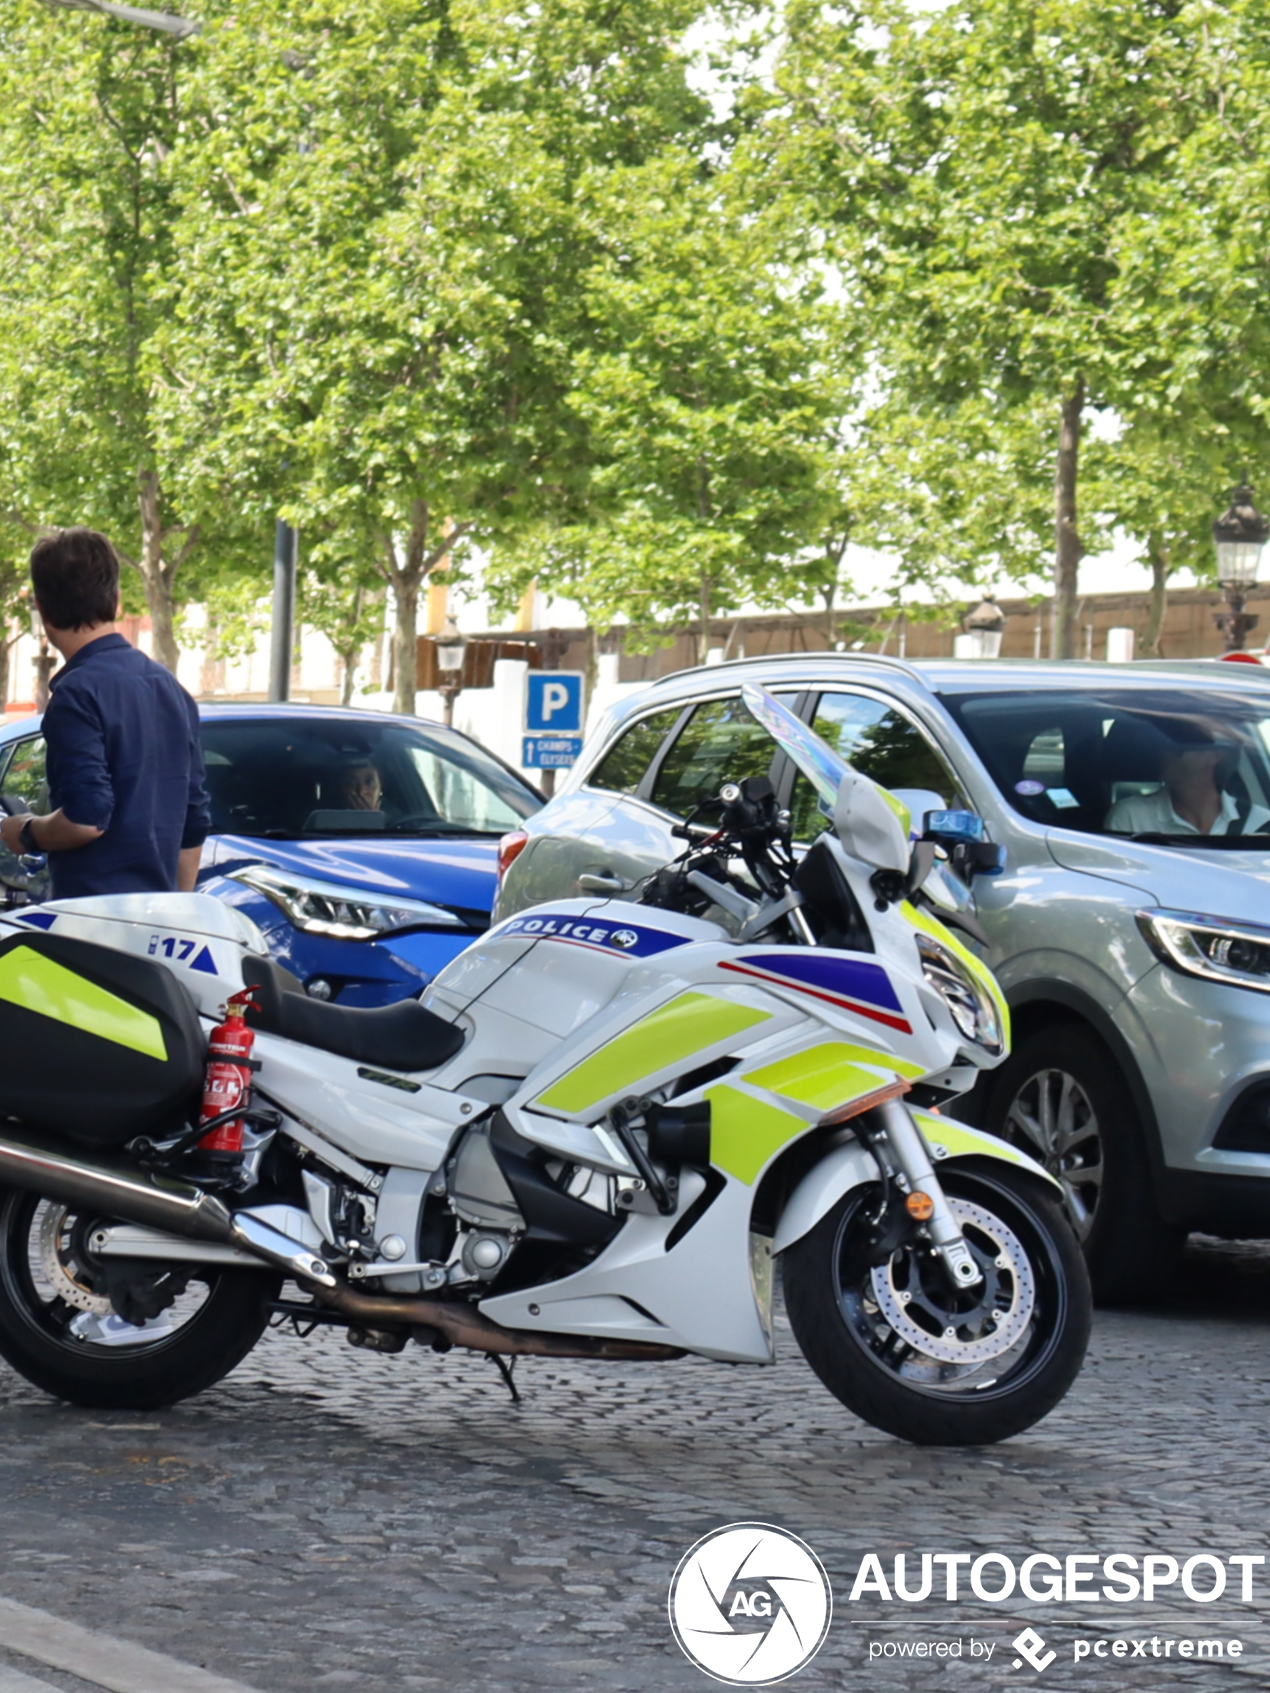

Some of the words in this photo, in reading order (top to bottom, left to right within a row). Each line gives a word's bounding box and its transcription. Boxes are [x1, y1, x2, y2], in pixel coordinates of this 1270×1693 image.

[542, 683, 569, 721] P
[505, 919, 609, 943] POLICE
[161, 937, 197, 961] 17
